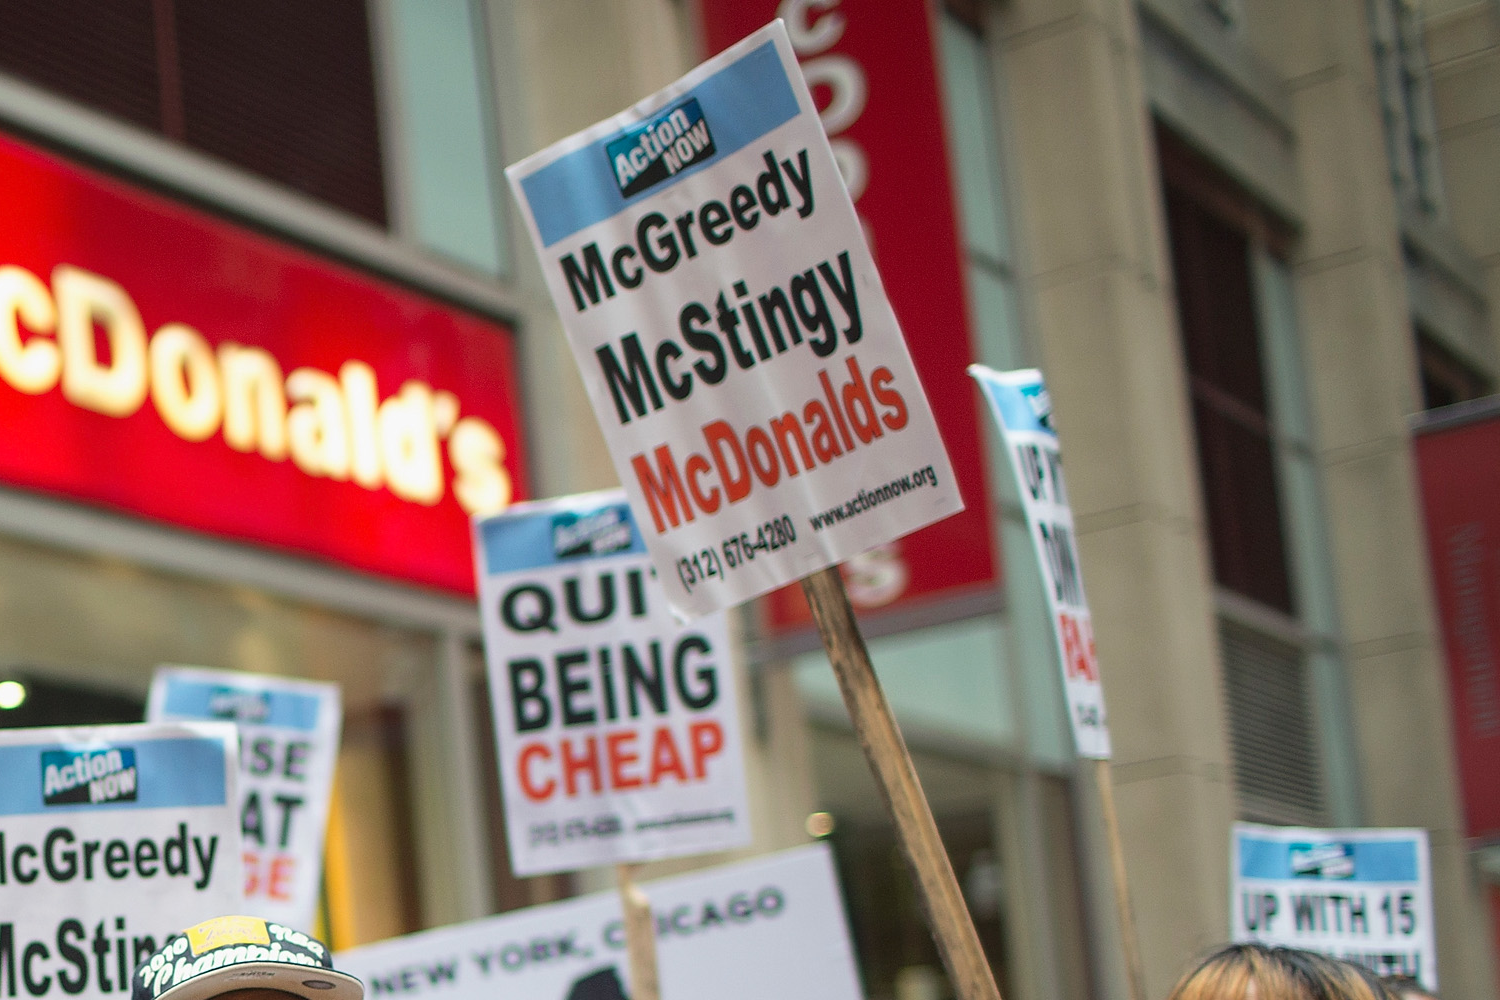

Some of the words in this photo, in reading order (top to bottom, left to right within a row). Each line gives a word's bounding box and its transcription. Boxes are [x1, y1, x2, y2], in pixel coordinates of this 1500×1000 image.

[615, 108, 691, 187] Action
[662, 119, 711, 176] NOW
[559, 148, 815, 312] McGreedy
[596, 251, 864, 425] McStingy
[630, 356, 909, 534] McDonalds
[677, 546, 724, 594] (312)
[722, 514, 797, 569] 676-4280
[809, 464, 938, 531] www.actionnow.org
[501, 567, 657, 633] QUI
[44, 749, 122, 796] Action
[89, 766, 135, 803] NOW
[516, 719, 725, 801] CHEAP
[371, 958, 457, 999] NEW
[473, 932, 594, 979] YORK,
[604, 887, 787, 952] CICAGO
[1243, 892, 1278, 932] UP
[1290, 892, 1369, 935] WITH
[1381, 892, 1415, 936] 15
[139, 937, 189, 989] 2010
